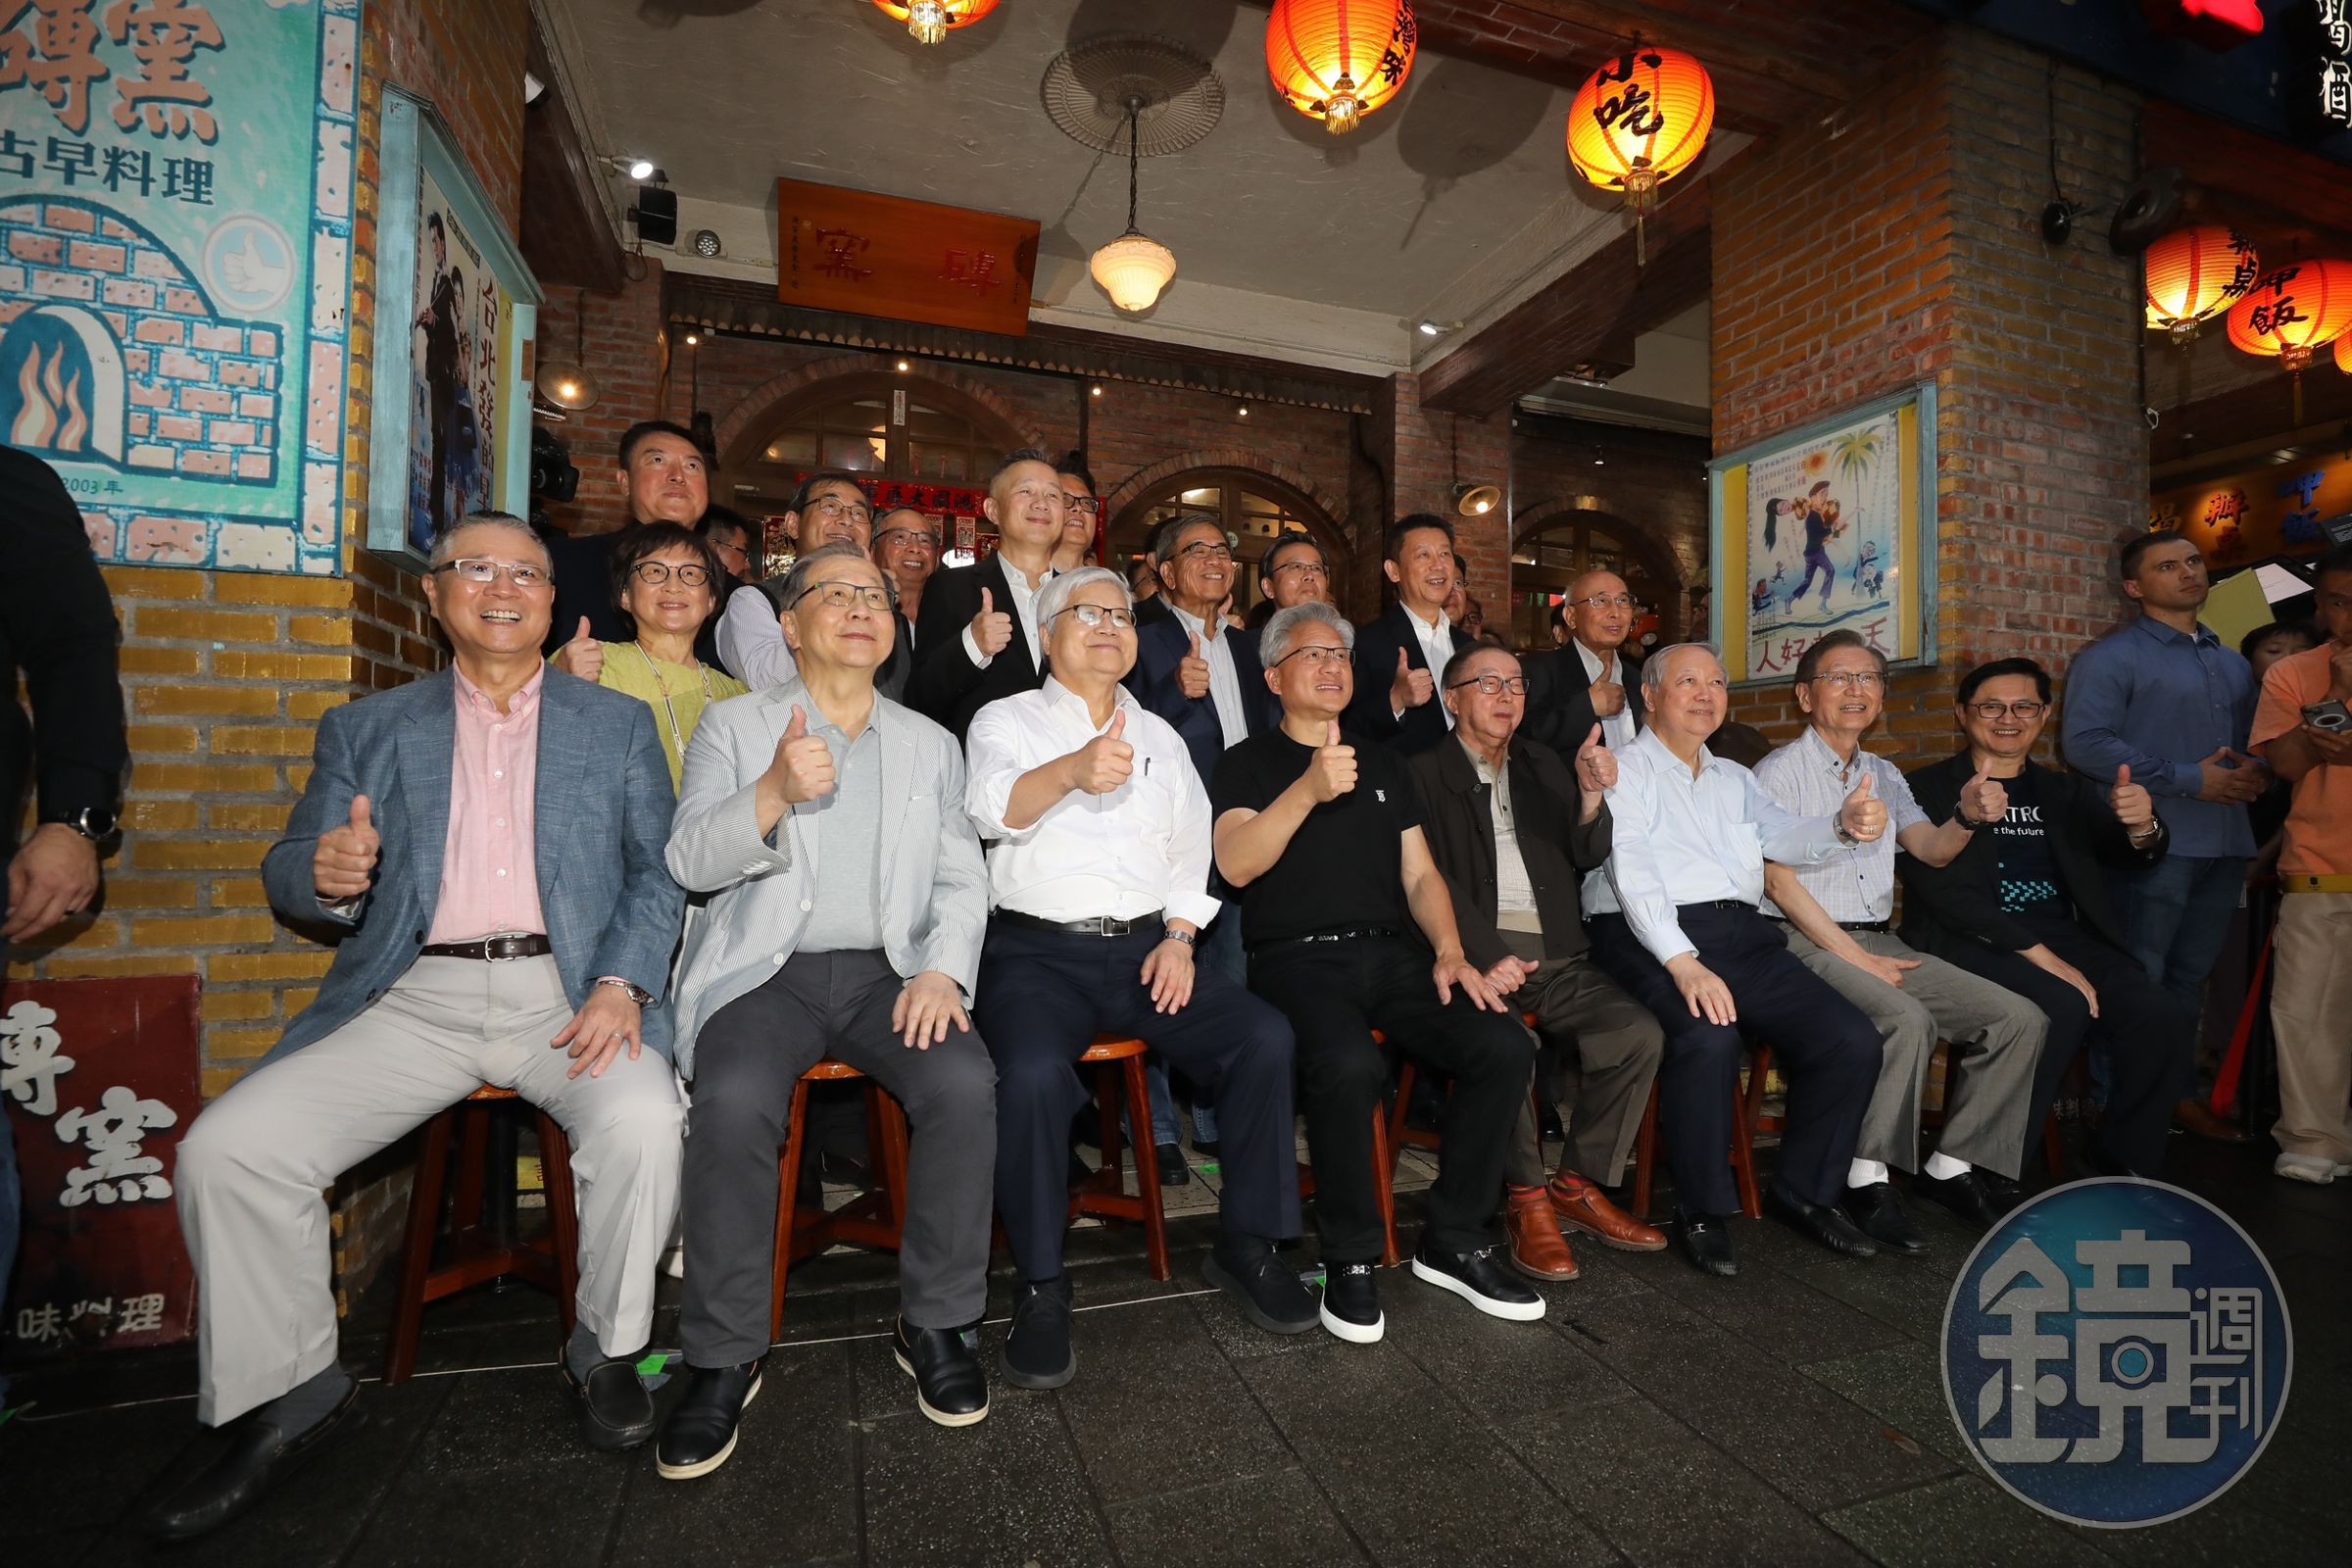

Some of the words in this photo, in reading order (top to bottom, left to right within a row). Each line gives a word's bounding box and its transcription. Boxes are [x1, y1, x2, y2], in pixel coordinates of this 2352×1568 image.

[1592, 52, 1665, 136] 小吃
[0, 128, 216, 207] 古早料理
[2001, 826, 2016, 836] the
[2017, 827, 2045, 836] future
